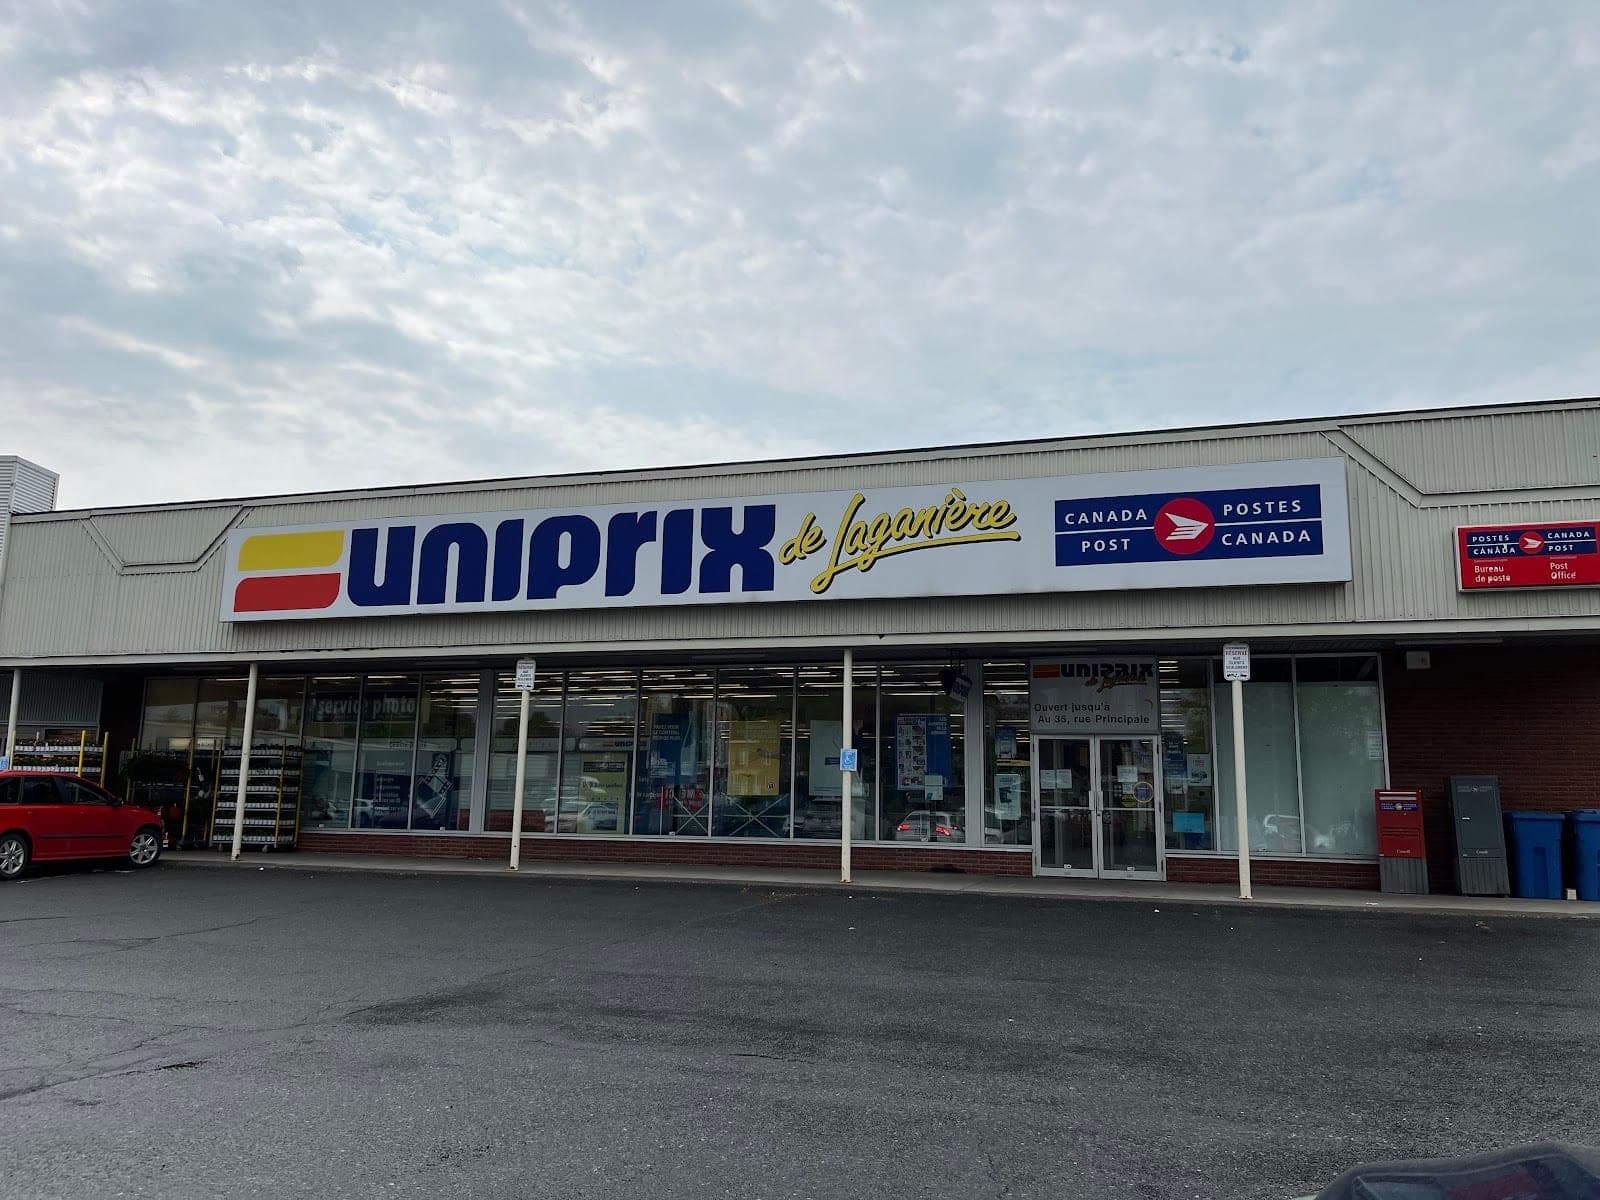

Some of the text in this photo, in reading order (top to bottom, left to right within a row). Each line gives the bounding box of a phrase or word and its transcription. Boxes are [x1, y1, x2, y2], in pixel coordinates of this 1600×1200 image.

[1223, 499, 1302, 516] POSTES
[1064, 508, 1148, 525] CANADA
[779, 512, 827, 565] de
[810, 487, 1021, 593] Laganière
[1221, 529, 1312, 546] CANADA
[1472, 534, 1510, 543] POSTES
[1547, 531, 1590, 539] CANADA
[1081, 538, 1131, 553] POST
[1473, 545, 1516, 555] CANADA
[1548, 544, 1573, 552] POST
[1474, 565, 1504, 573] Bureau
[1550, 562, 1568, 570] Post
[1475, 573, 1511, 583] de poste
[1551, 571, 1576, 580] Office
[372, 692, 416, 720] photo
[1034, 703, 1068, 712] Ouvert
[1038, 715, 1051, 724] Au
[1054, 715, 1070, 725] 35,
[1095, 714, 1150, 725] Principale
